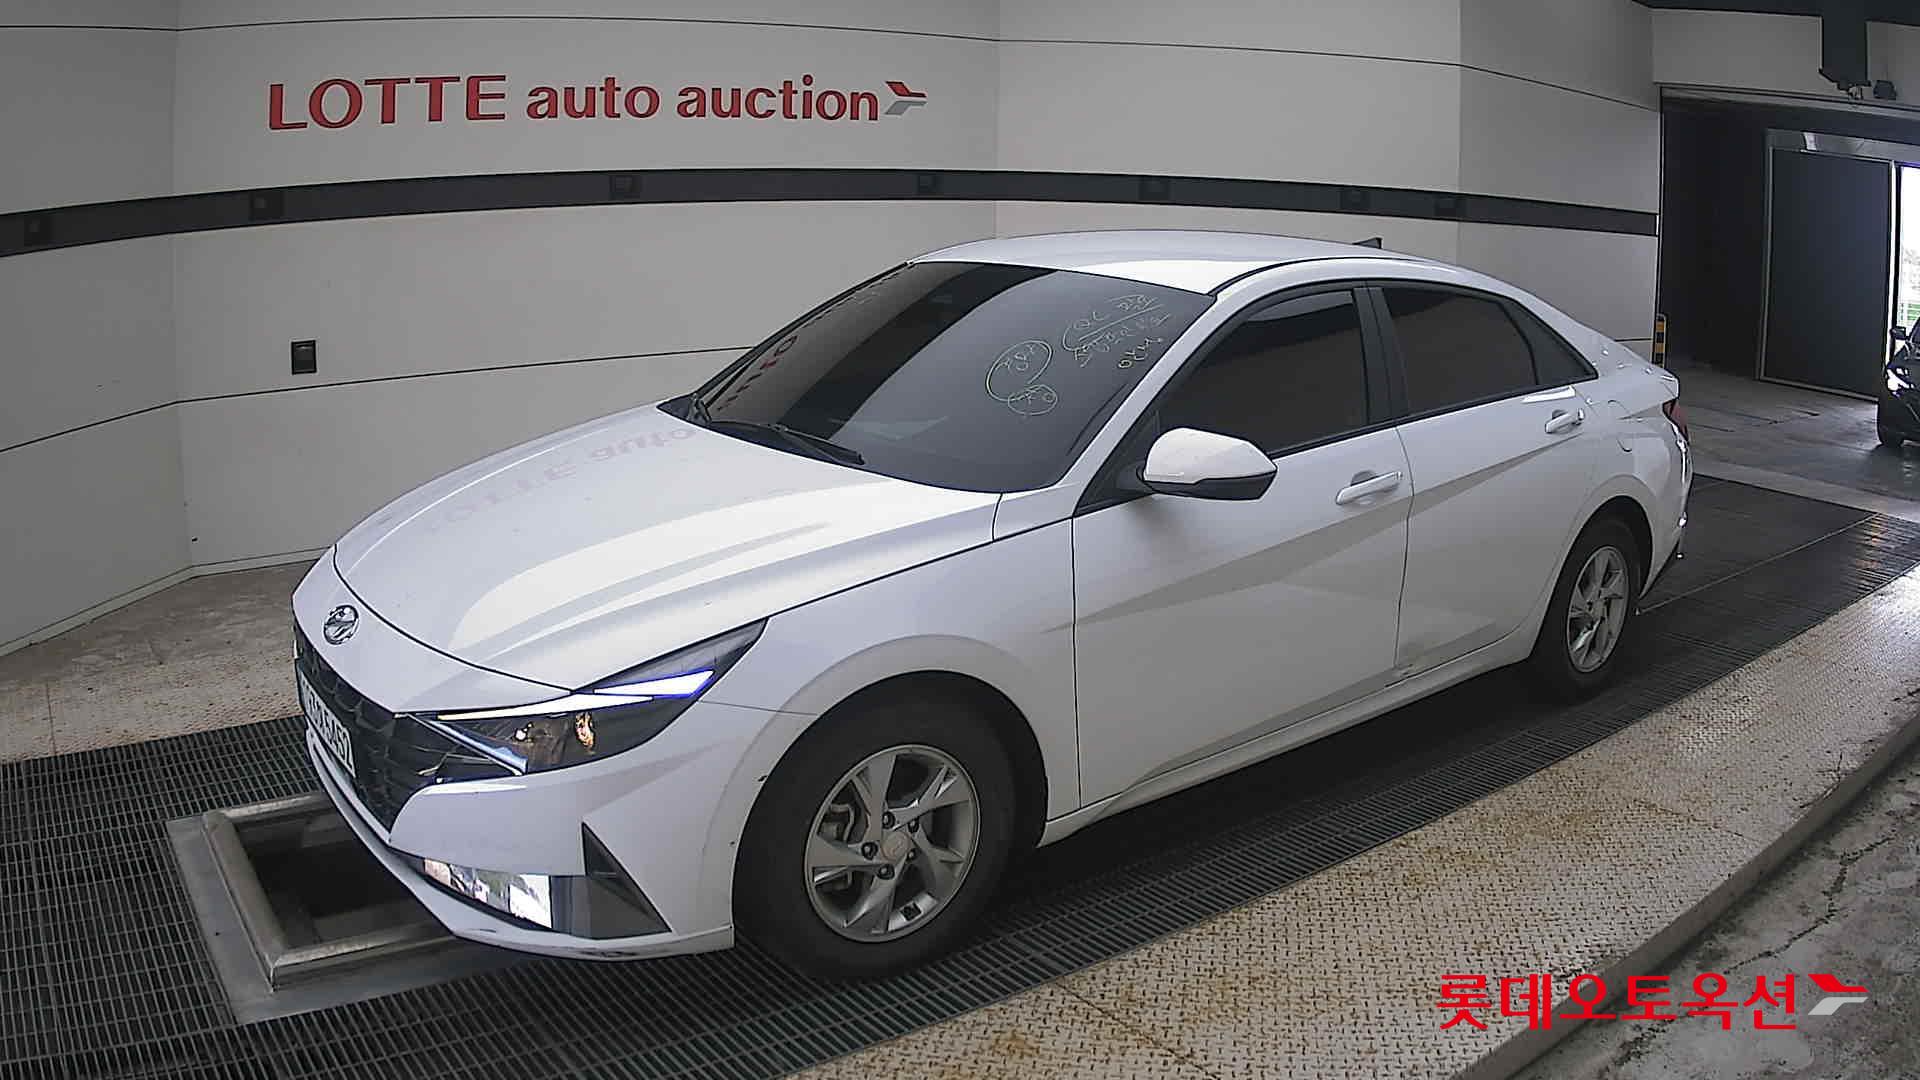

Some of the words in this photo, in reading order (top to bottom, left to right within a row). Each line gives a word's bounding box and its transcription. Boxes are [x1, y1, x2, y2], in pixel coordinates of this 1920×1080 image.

[268, 74, 507, 131] LOTTE
[525, 77, 661, 121] auto
[675, 74, 880, 122] auction
